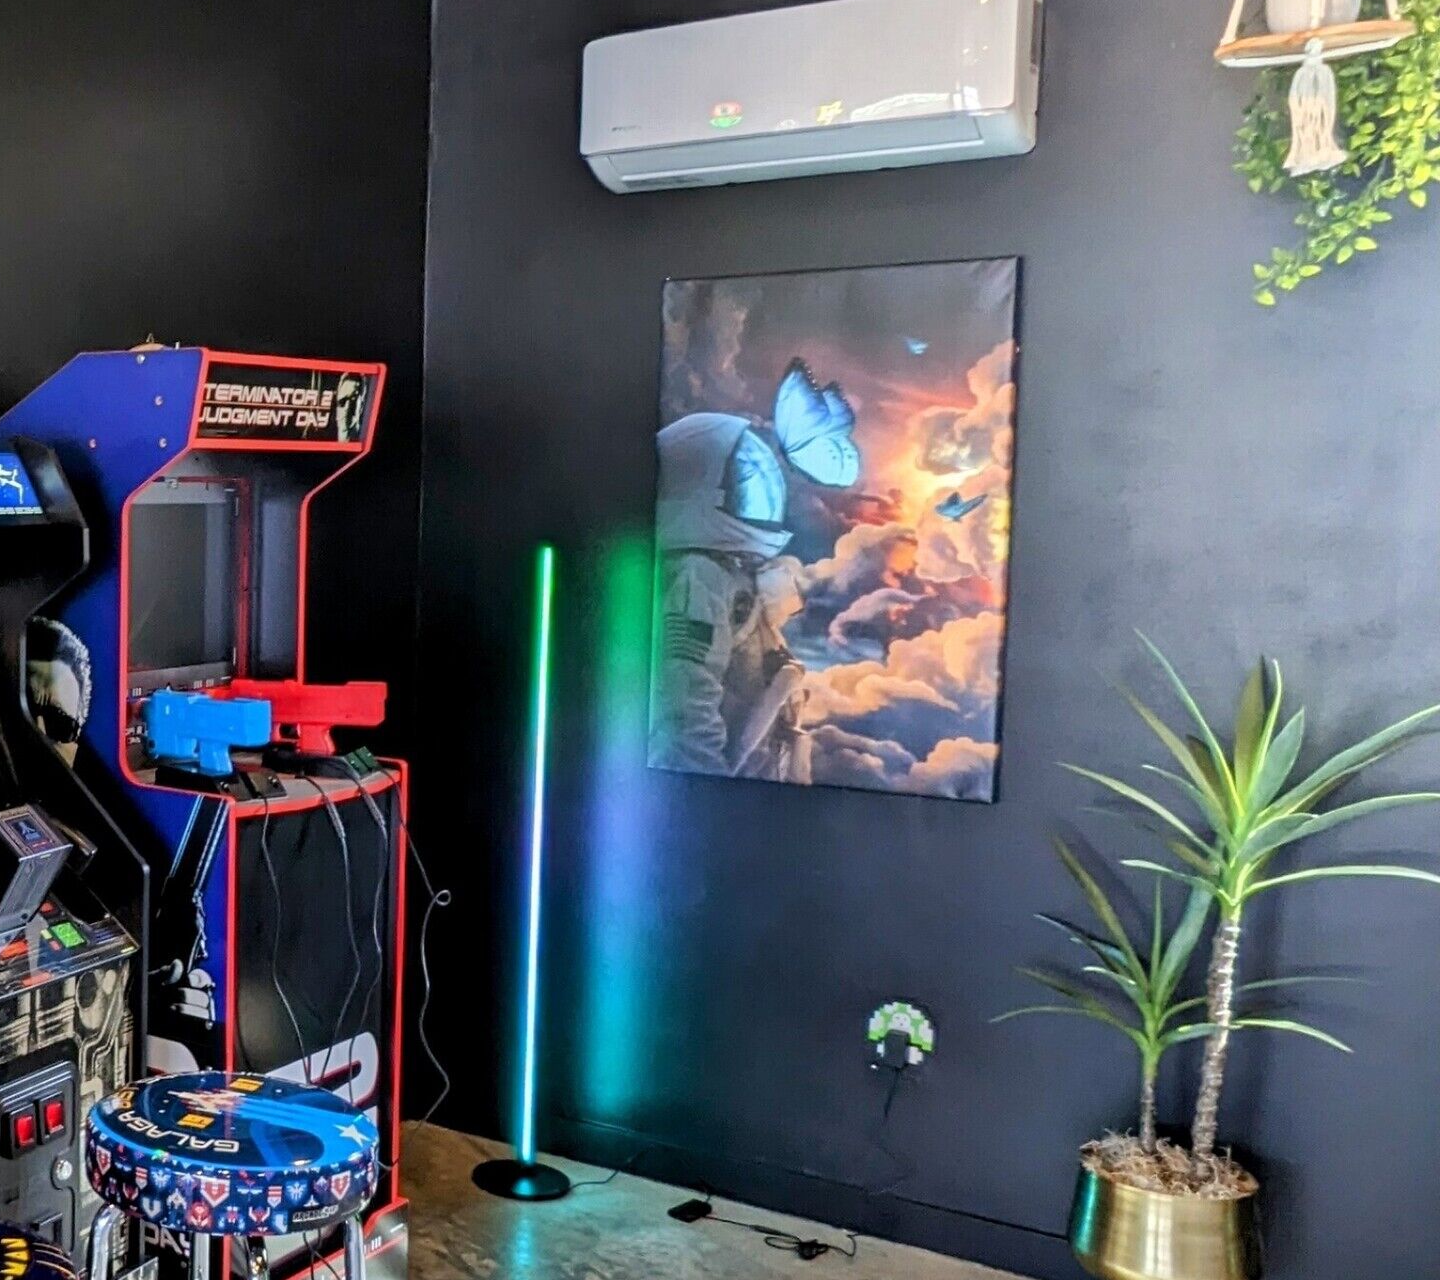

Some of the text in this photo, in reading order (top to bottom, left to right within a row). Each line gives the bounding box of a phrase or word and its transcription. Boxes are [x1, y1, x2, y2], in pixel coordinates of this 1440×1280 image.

[204, 383, 334, 405] TERMINATOR 2
[199, 407, 330, 428] JUDGMENT DAY
[118, 1109, 241, 1154] GALAGA
